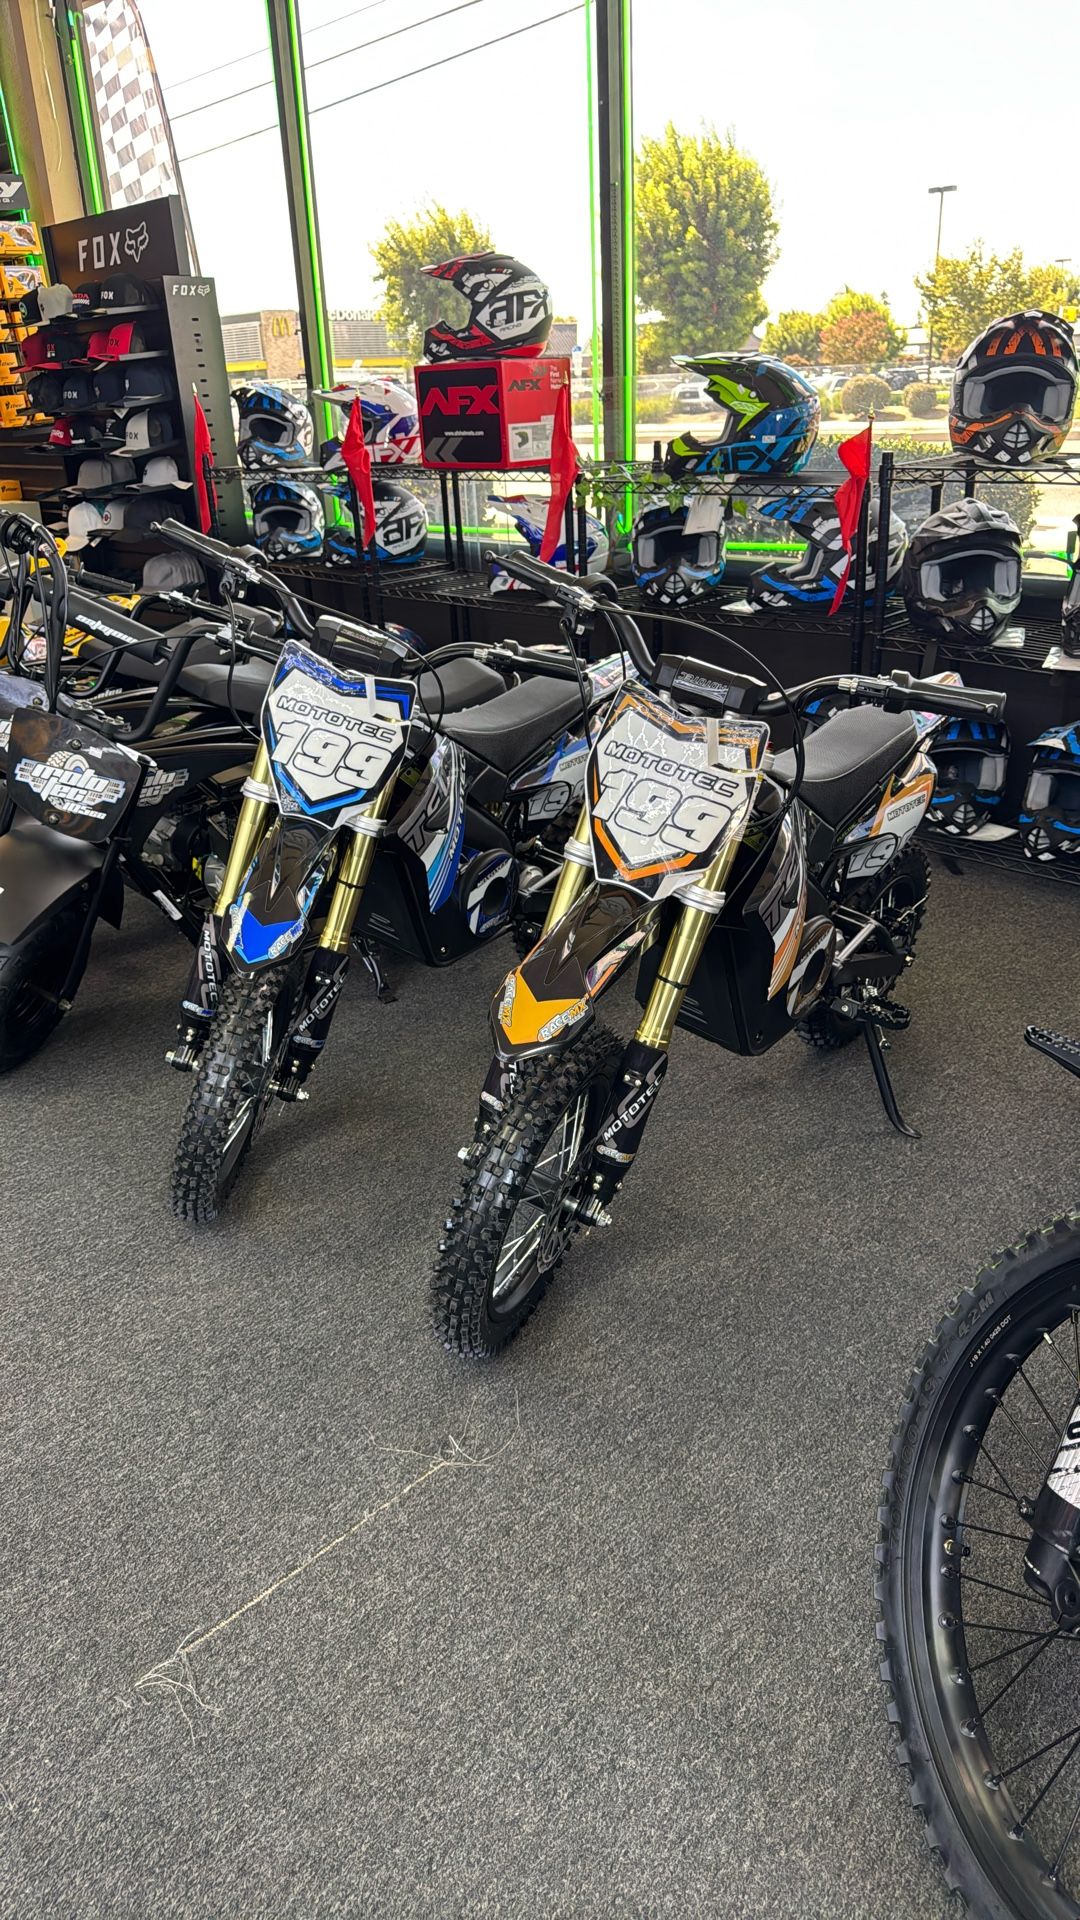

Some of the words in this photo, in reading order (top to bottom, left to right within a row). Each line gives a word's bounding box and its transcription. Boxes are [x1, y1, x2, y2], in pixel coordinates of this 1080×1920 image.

[78, 231, 121, 272] FOX
[101, 290, 114, 300] FOX
[172, 284, 197, 297] FOX
[63, 391, 78, 400] FOX
[421, 385, 500, 416] AFX
[508, 379, 542, 392] AFX
[277, 696, 397, 744] MOTOTEC
[271, 719, 393, 790] 199
[604, 740, 739, 798] MOTOTEC
[592, 768, 734, 853] 199
[886, 793, 926, 821] MOTOTEC
[203, 929, 219, 1003] MOTOTEC
[603, 1073, 664, 1142] MOTOTEC
[958, 1290, 995, 1338] 42M
[1000, 1314, 1012, 1328] DOT
